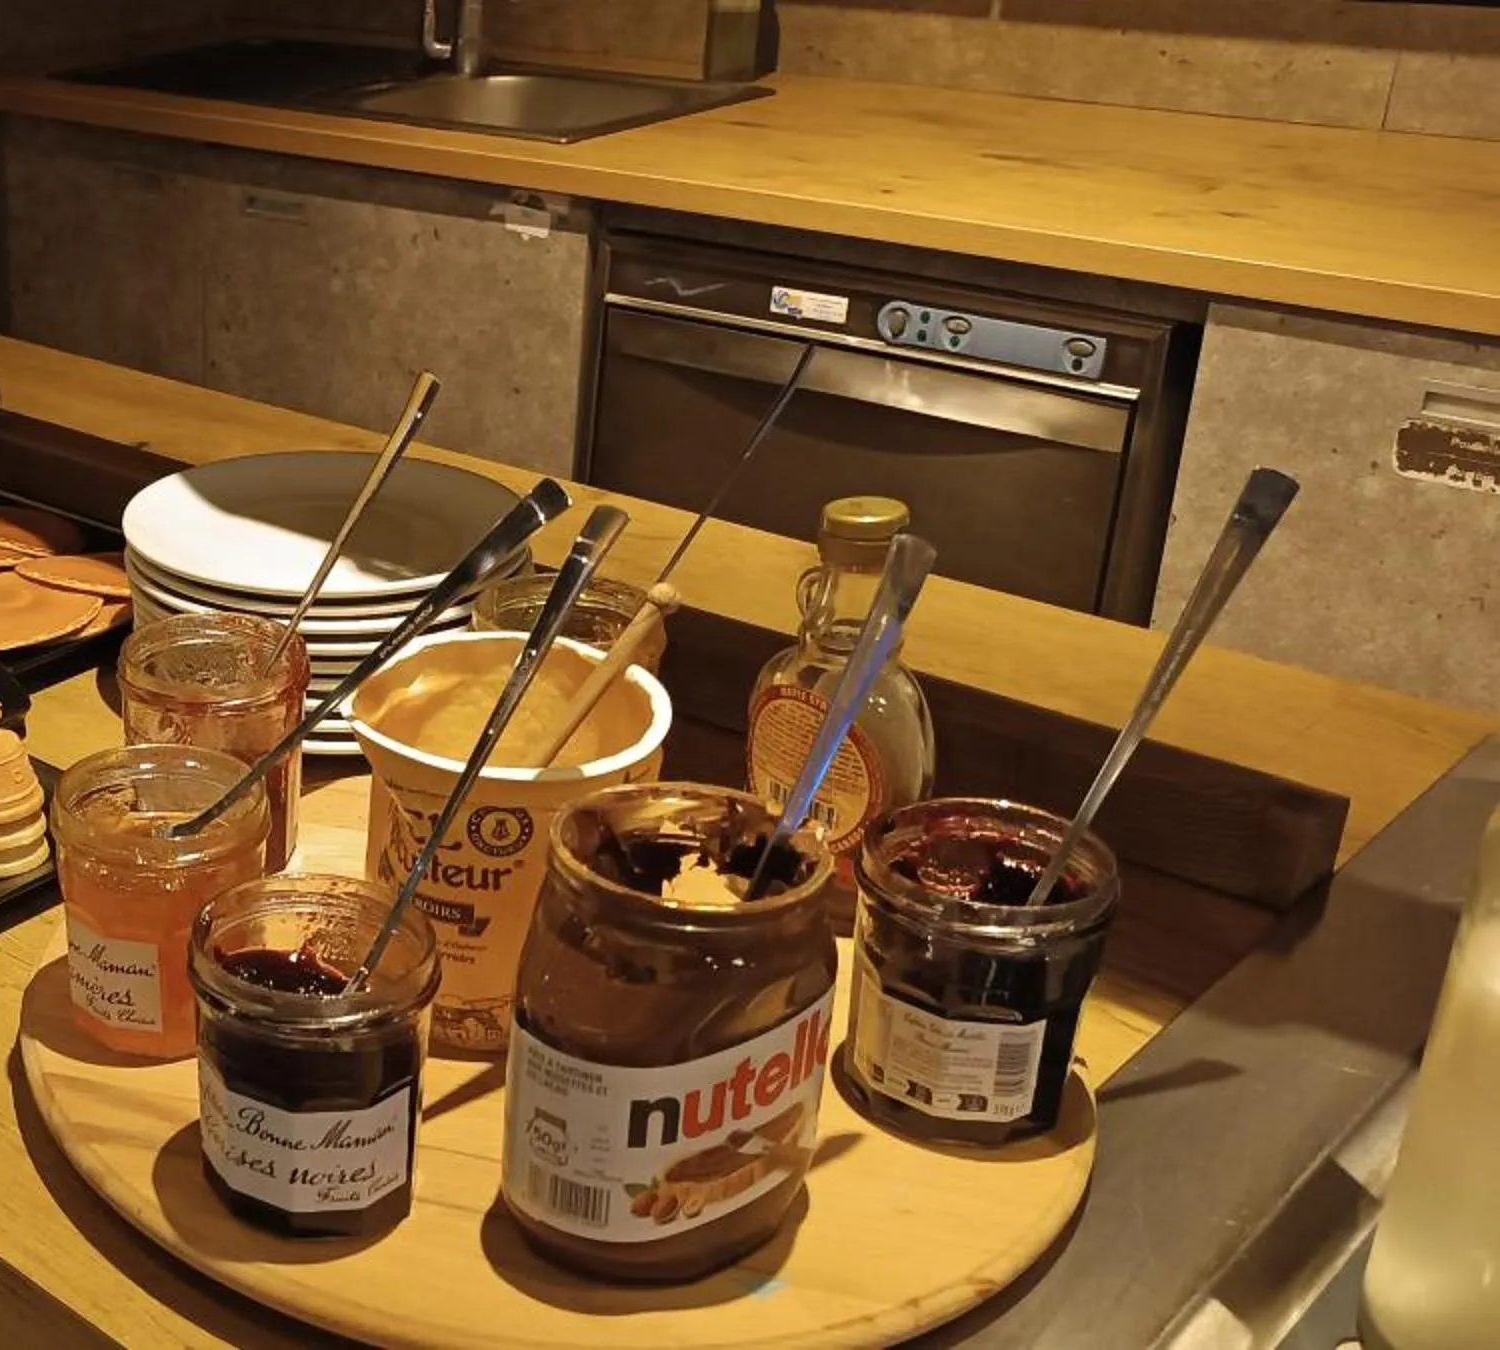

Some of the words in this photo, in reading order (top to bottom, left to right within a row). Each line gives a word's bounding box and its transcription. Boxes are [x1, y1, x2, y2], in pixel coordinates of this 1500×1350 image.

[235, 1106, 309, 1151] Bonne
[310, 1119, 395, 1151] Maman
[289, 1158, 376, 1186] noires
